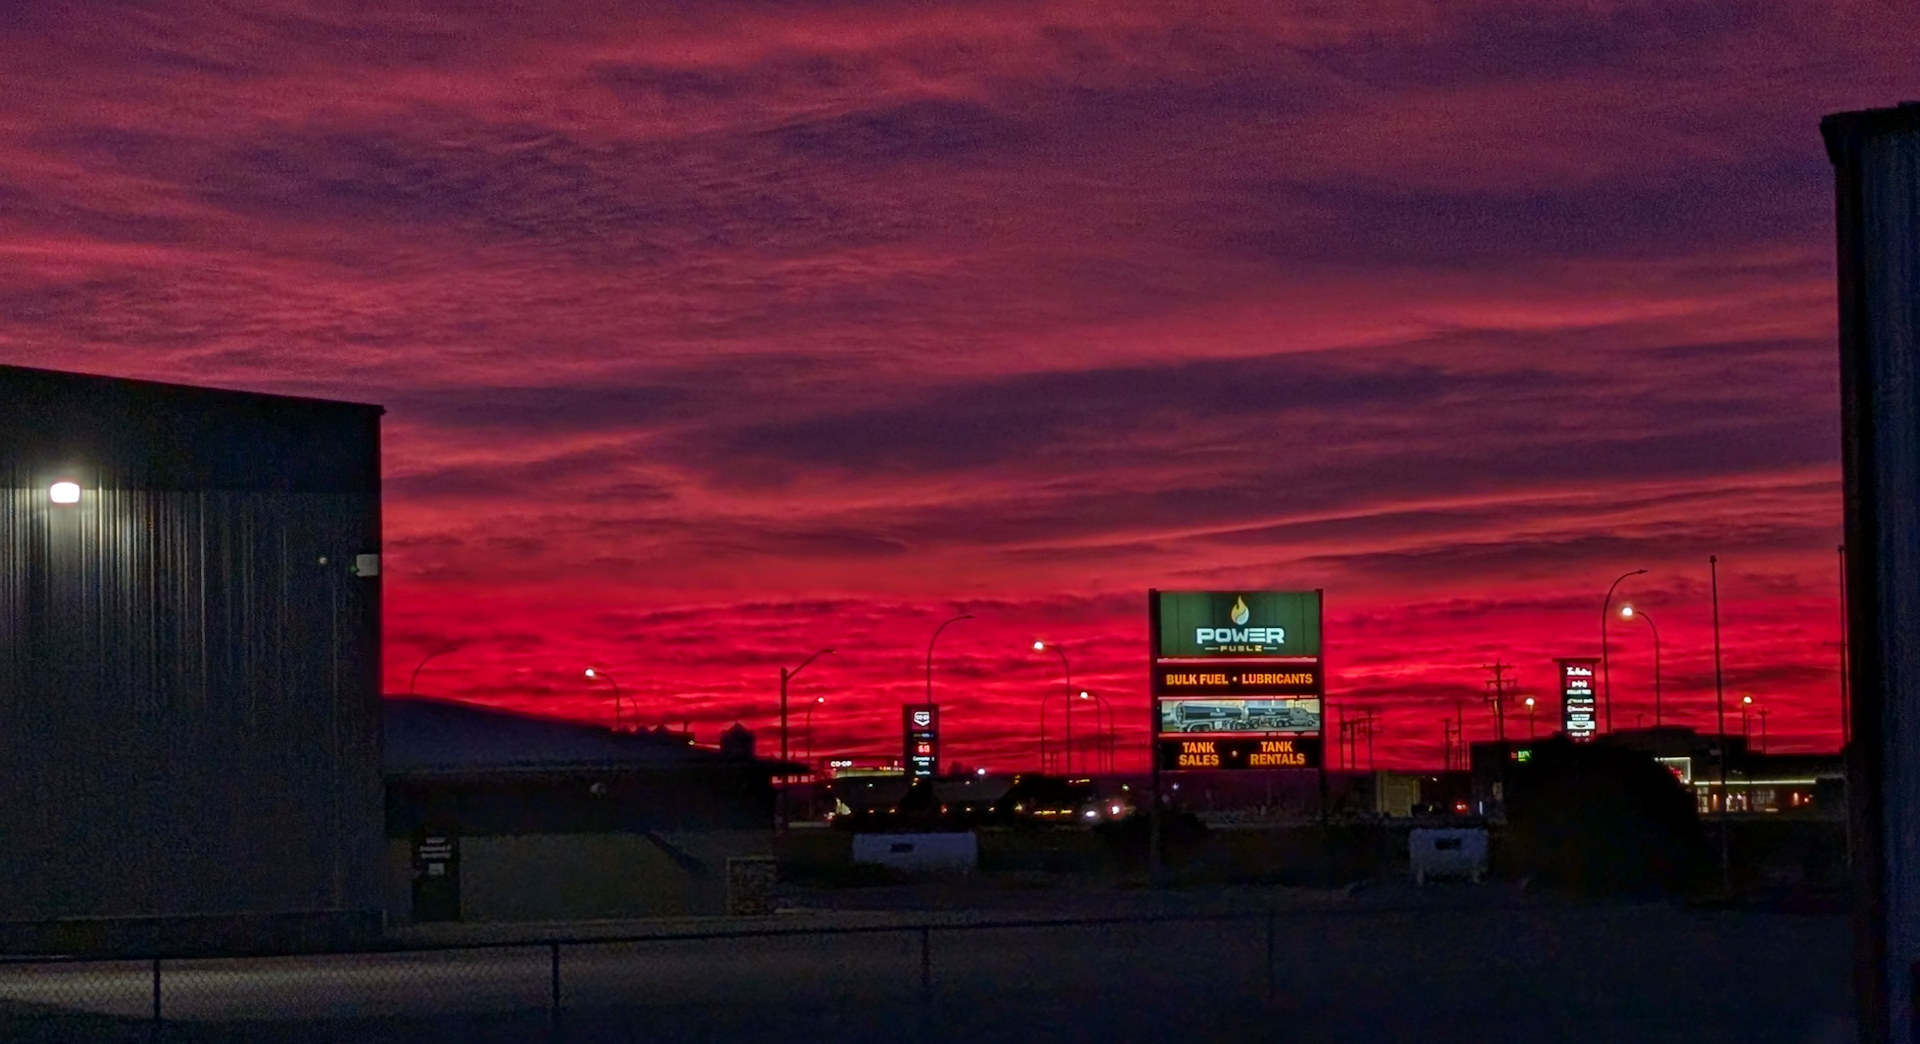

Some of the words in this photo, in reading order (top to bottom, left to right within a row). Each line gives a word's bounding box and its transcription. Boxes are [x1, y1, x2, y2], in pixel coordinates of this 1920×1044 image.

[1196, 628, 1284, 644] POWER
[1166, 674, 1197, 685] BULK
[1200, 674, 1229, 685] FUEL
[1242, 673, 1313, 685] LUBRICANTS
[1182, 742, 1215, 753] TANK
[1261, 741, 1293, 752] TANK
[1178, 754, 1220, 766] SALES
[1250, 753, 1305, 765] RENTALS
